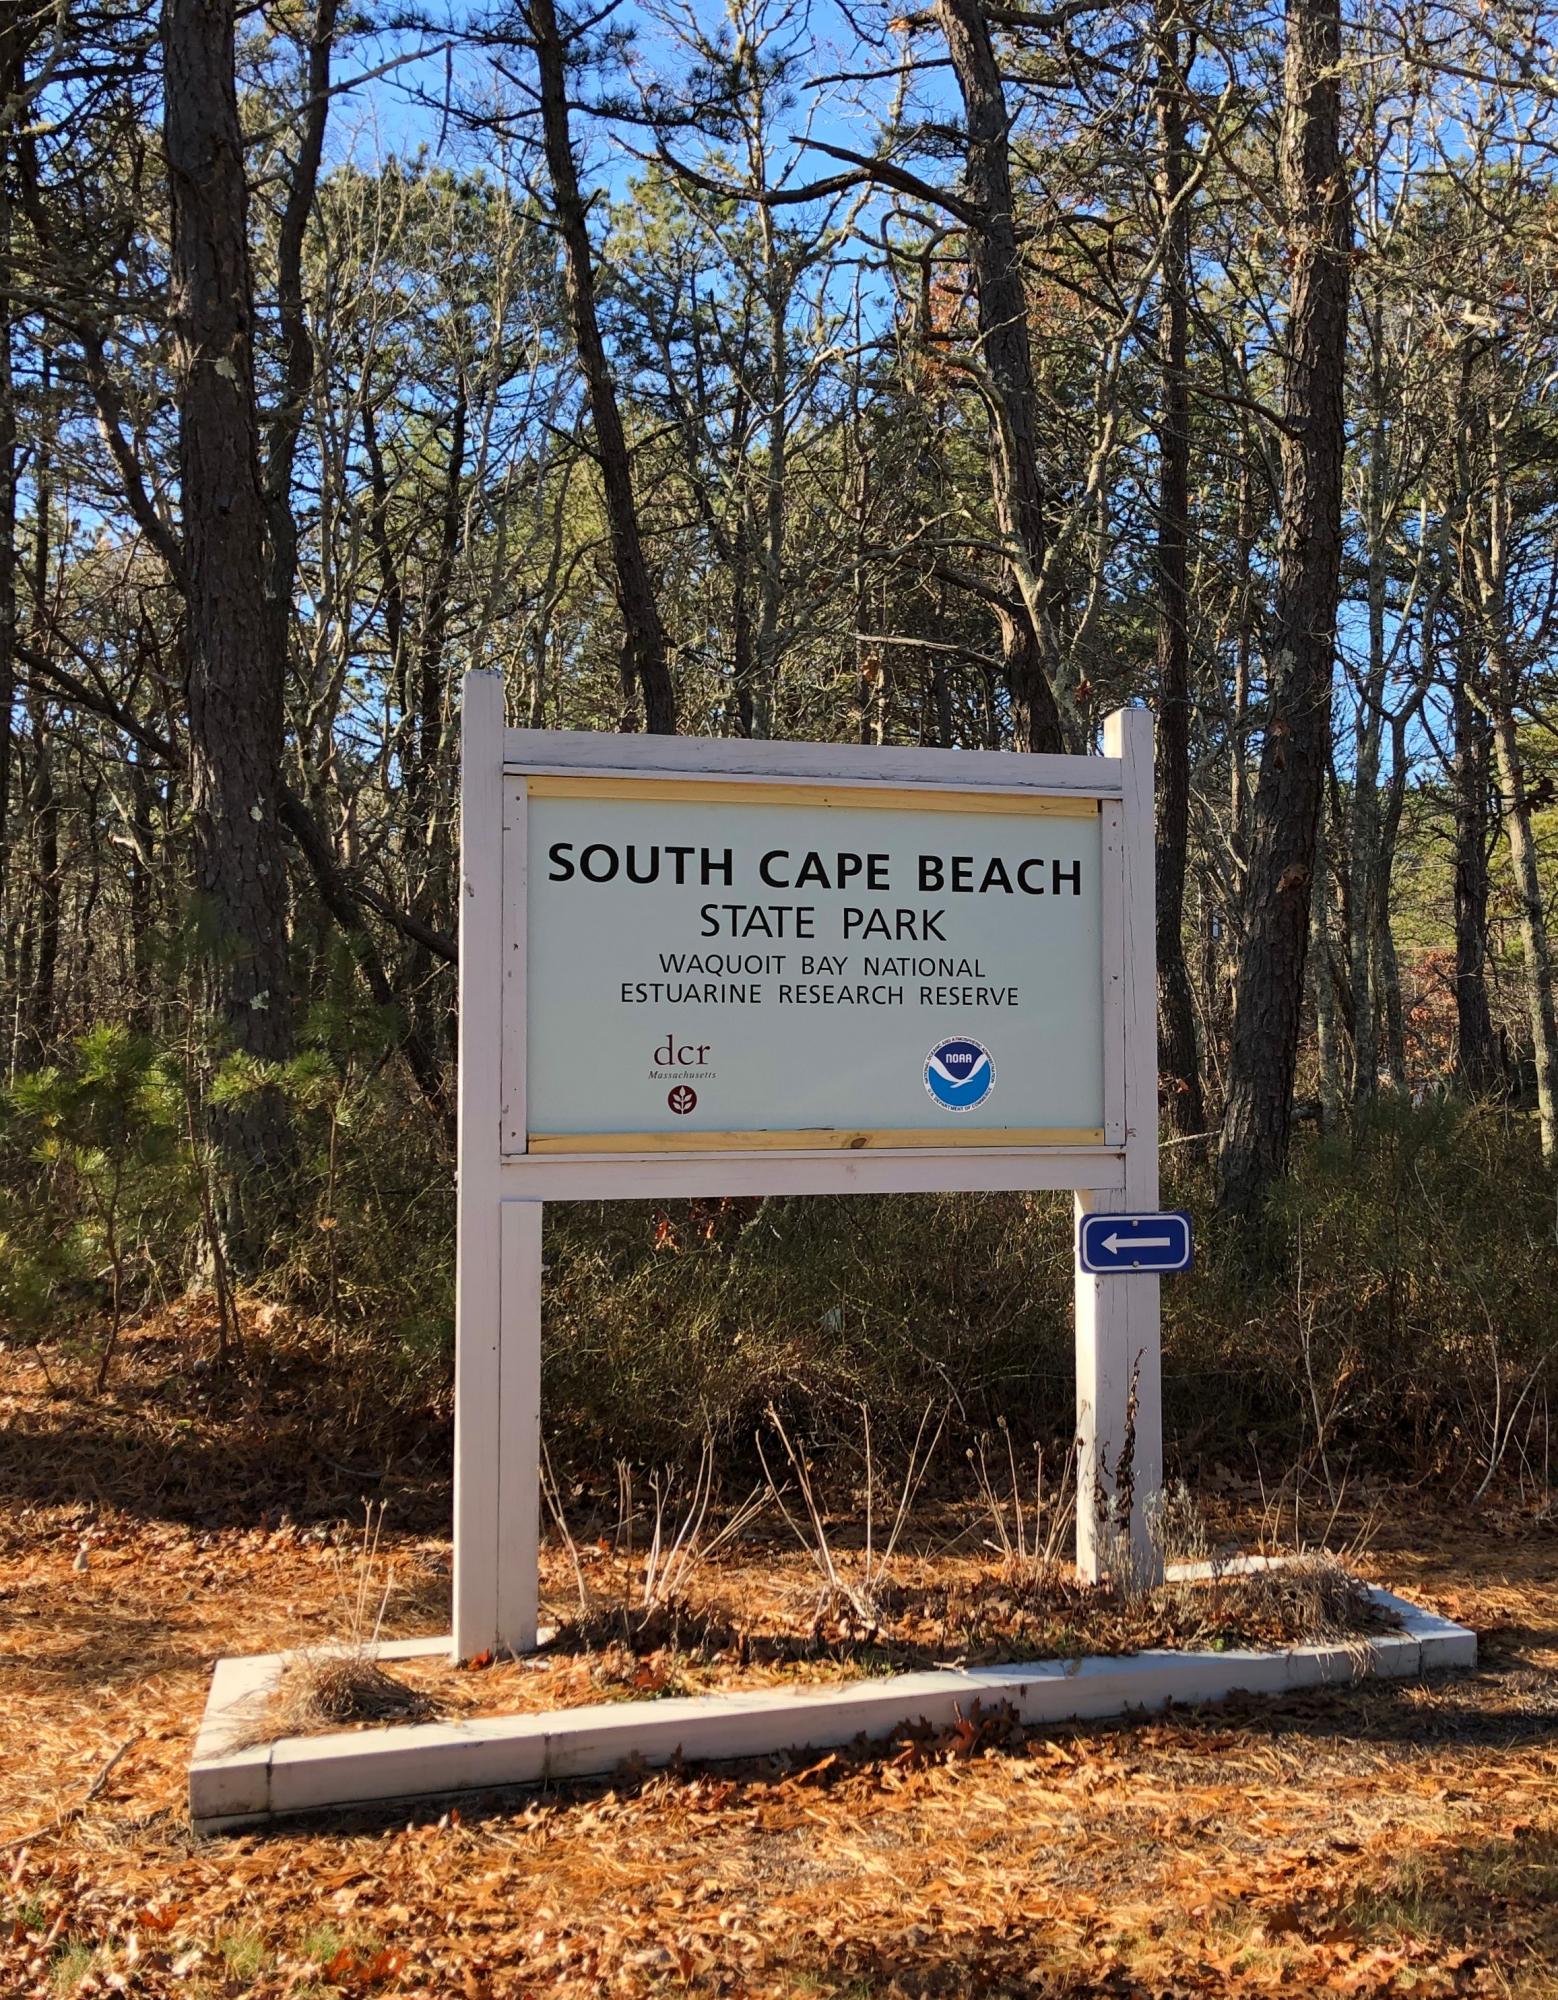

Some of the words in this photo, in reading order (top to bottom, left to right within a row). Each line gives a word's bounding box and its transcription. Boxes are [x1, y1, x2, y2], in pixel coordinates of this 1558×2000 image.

[548, 842, 733, 887] SOUTH
[758, 849, 890, 891] CAPE
[918, 854, 1081, 896] BEACH
[700, 903, 815, 939] STATE
[843, 907, 947, 942] PARK
[658, 953, 787, 978] WAQUOIT
[801, 955, 849, 976] BAY
[863, 956, 986, 978] NATIONAL
[621, 982, 762, 1004] ESTUARINE
[779, 984, 903, 1005] RESEARCH
[919, 985, 1019, 1006] RESERVE
[653, 1033, 711, 1066] dcr
[946, 1054, 972, 1063] NOAA
[648, 1070, 718, 1080] Massachusetts
